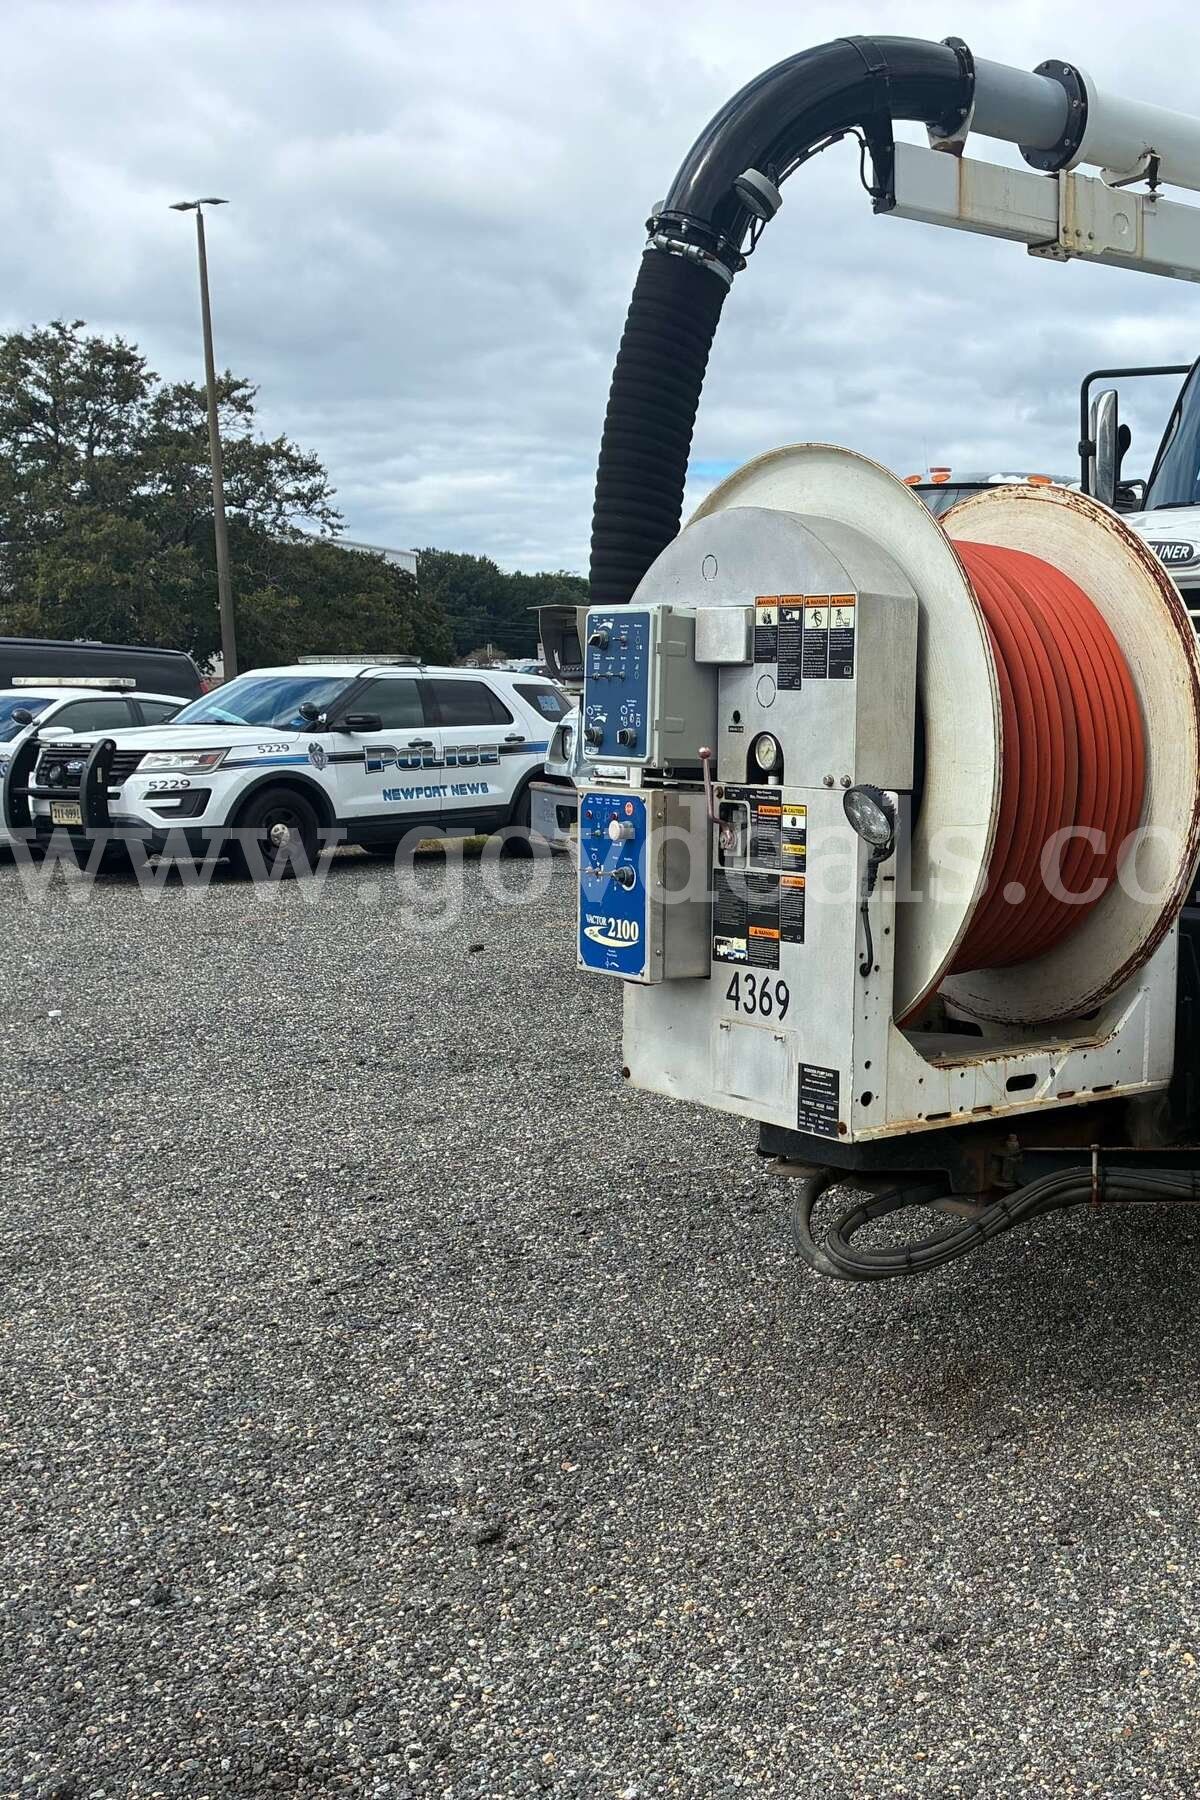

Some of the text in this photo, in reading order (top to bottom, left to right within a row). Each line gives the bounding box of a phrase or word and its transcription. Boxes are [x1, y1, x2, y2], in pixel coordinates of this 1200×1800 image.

[257, 744, 290, 754] 5229
[362, 744, 501, 774] POLICE
[148, 779, 191, 790] 5229
[382, 782, 489, 801] NEWPORT NEWS
[585, 913, 607, 926] VACTOR
[607, 917, 639, 941] 2100
[726, 971, 790, 1021] 4369
